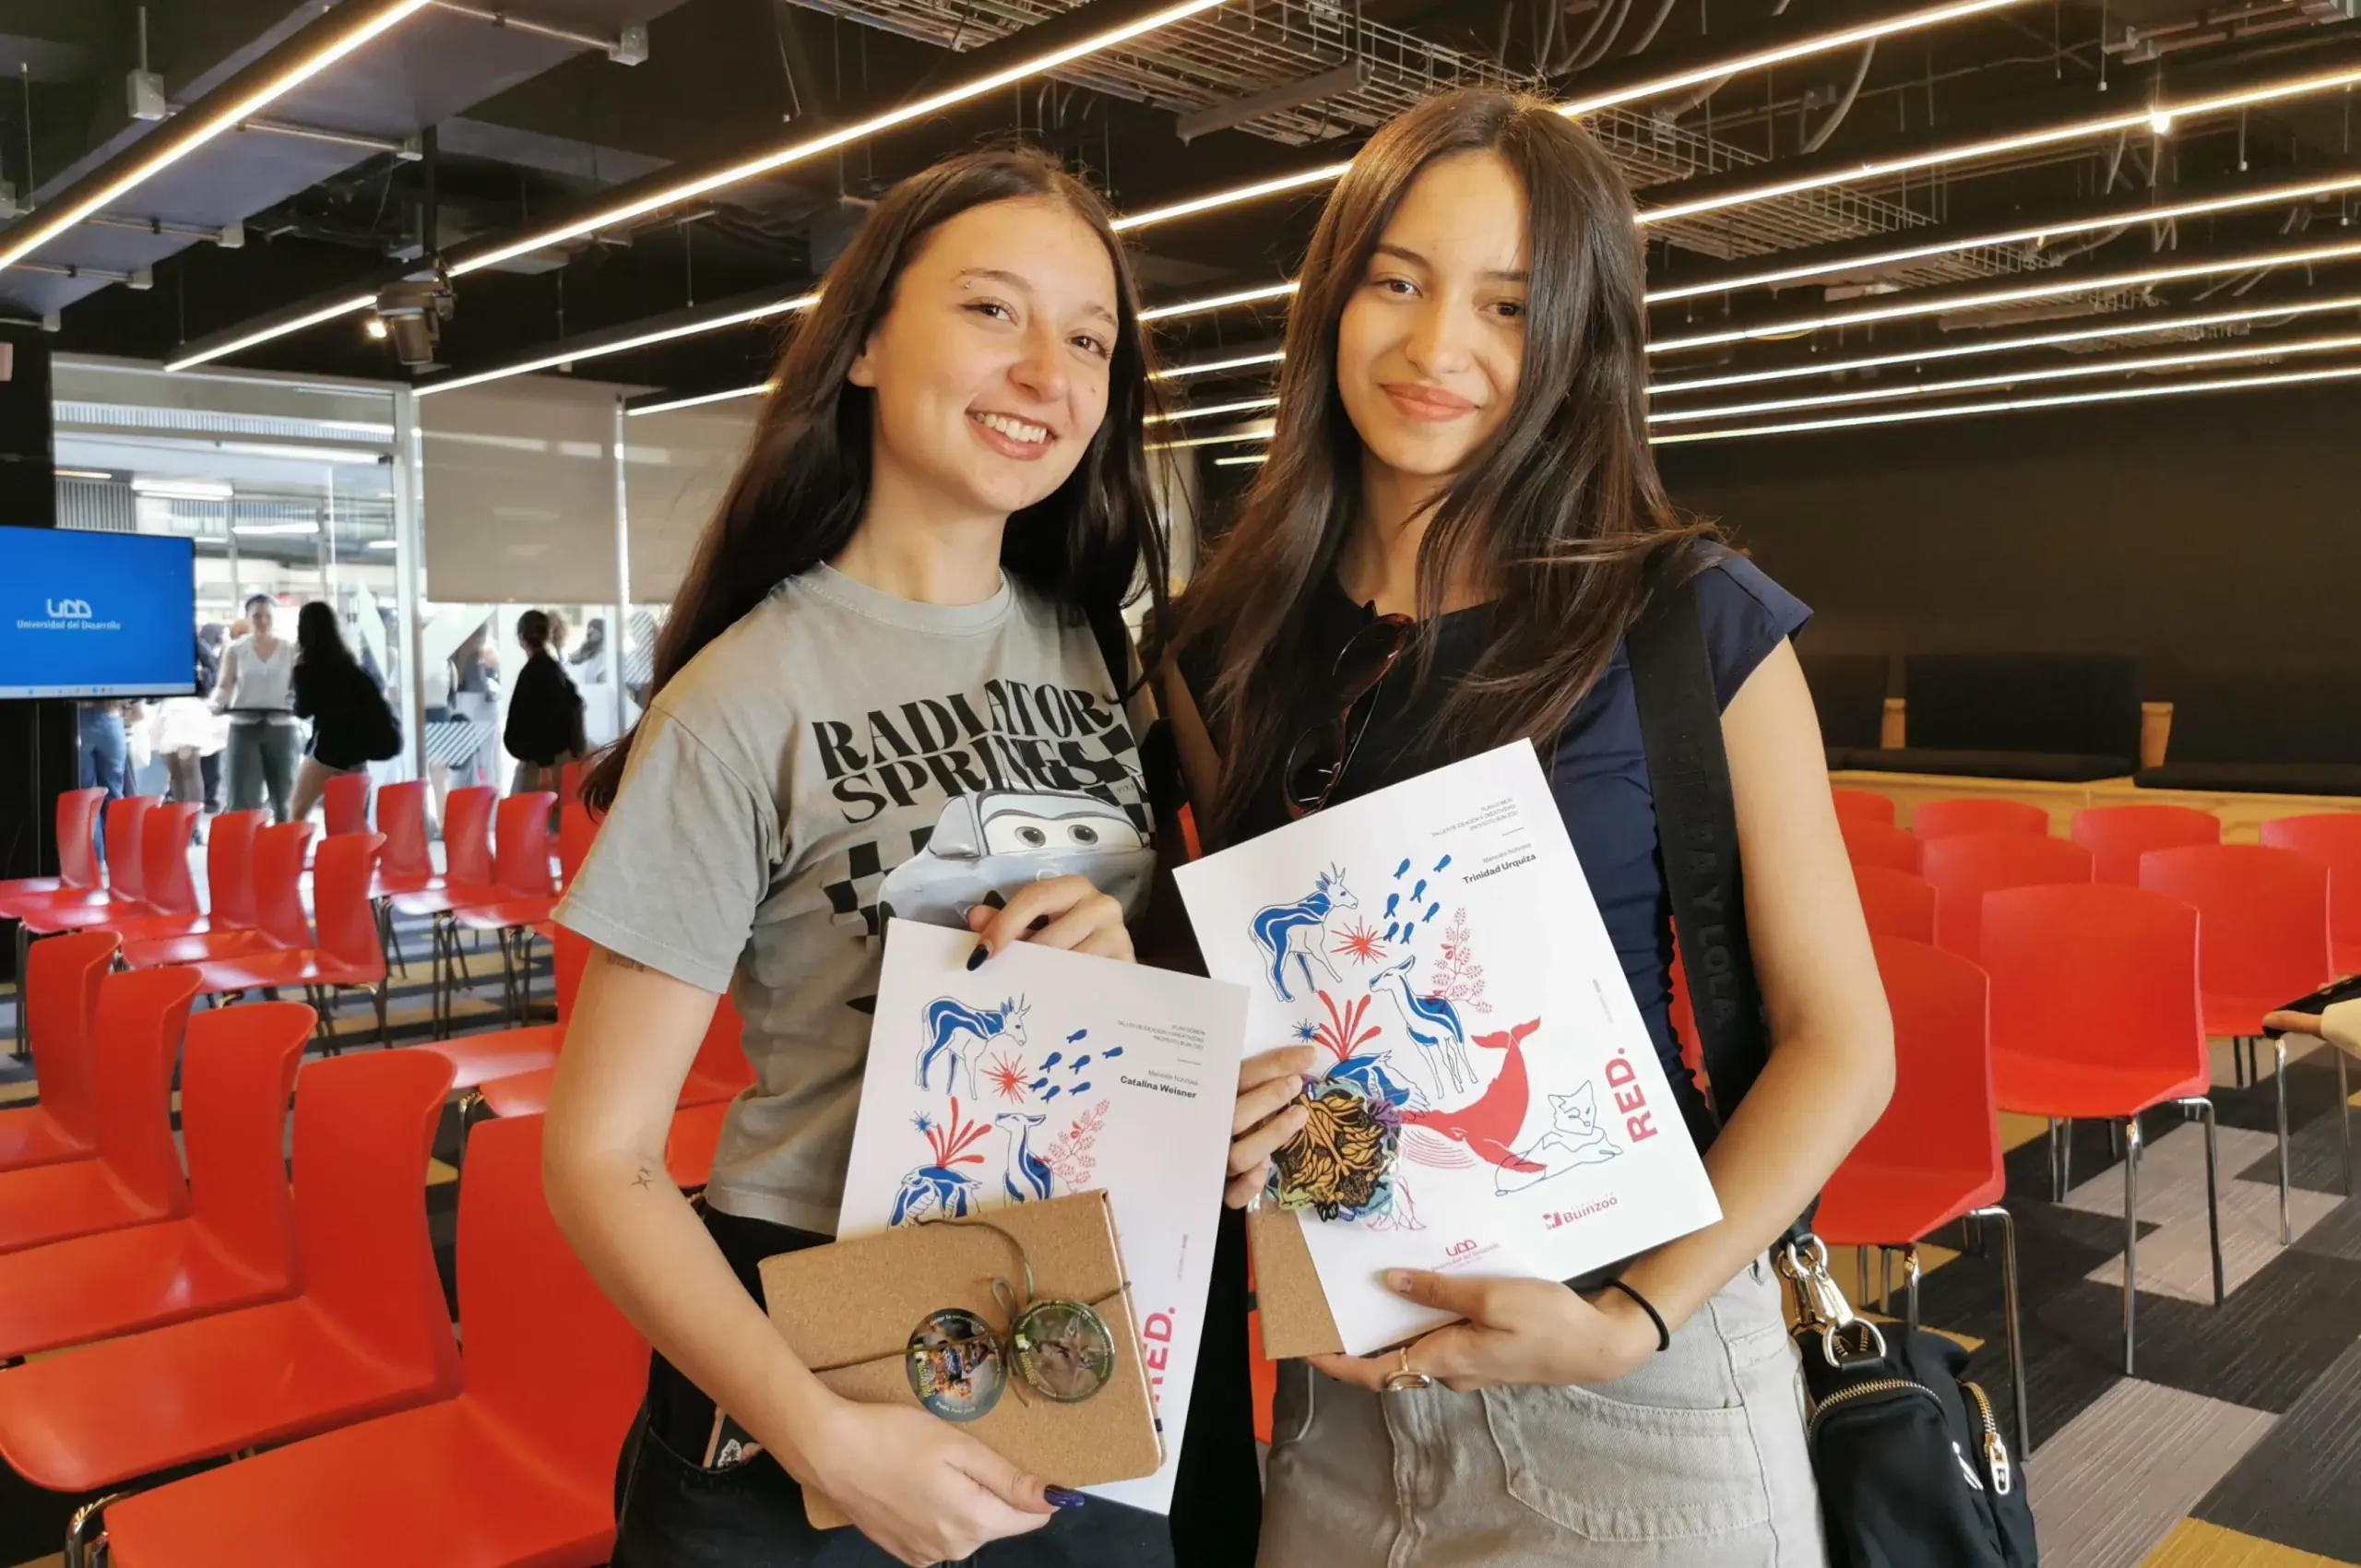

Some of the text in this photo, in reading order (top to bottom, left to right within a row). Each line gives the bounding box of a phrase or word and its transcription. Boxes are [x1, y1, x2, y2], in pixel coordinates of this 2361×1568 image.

[812, 679, 1113, 780] RADIATOR
[832, 734, 1102, 824] SPRINGS
[1462, 854, 1536, 885] Trinidad Urquiza
[1120, 1075, 1197, 1099] Catalina Weisner
[1605, 1047, 1658, 1143] RED.
[1563, 1196, 1618, 1223] Buinzoo
